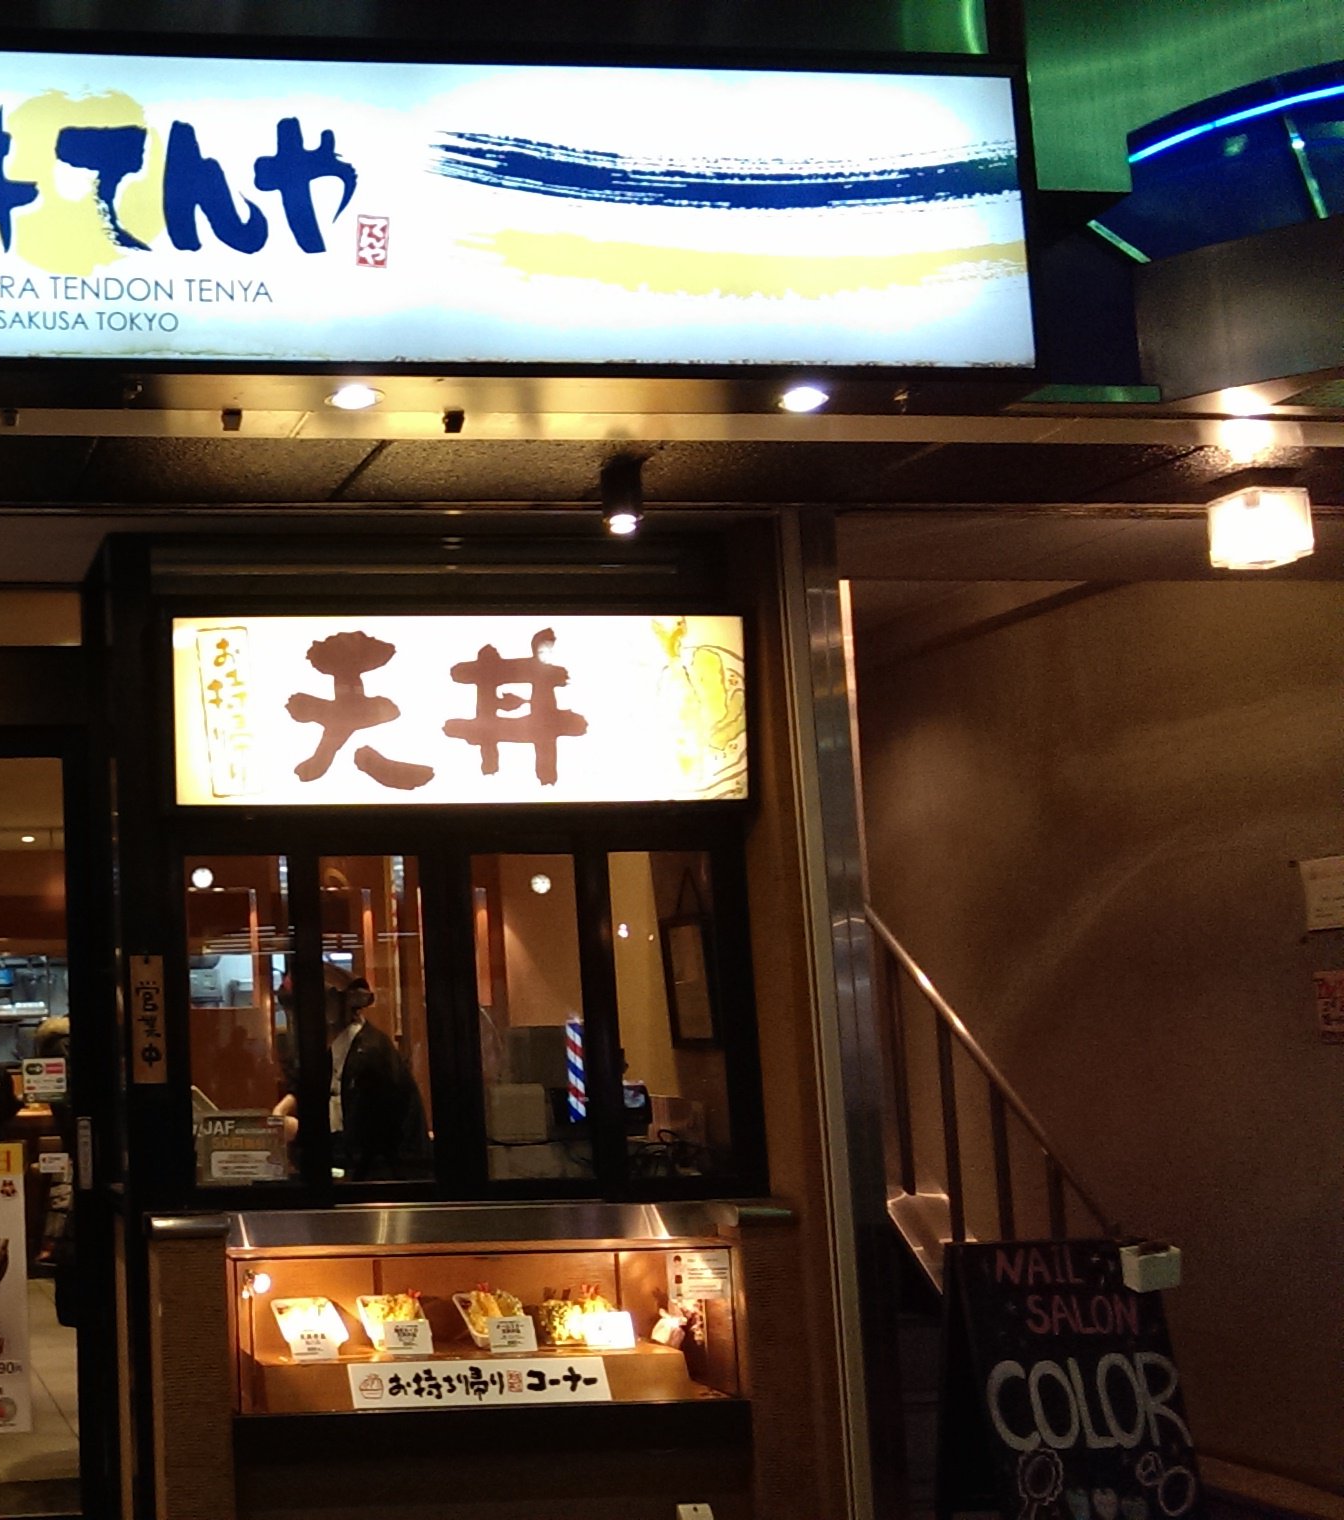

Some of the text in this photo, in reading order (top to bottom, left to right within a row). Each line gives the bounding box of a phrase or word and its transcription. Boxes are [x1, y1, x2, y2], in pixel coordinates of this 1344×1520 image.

[49, 275, 175, 303] TENDON
[183, 277, 274, 304] TENYA
[96, 311, 179, 333] TOKYO
[285, 627, 589, 791] 天丼
[203, 1119, 236, 1136] JAF
[994, 1245, 1084, 1286] NAIL
[1025, 1294, 1141, 1336] SALON
[388, 1366, 505, 1401] お持ち帰り
[526, 1366, 599, 1393] コーナー
[985, 1351, 1194, 1452] COLOR
